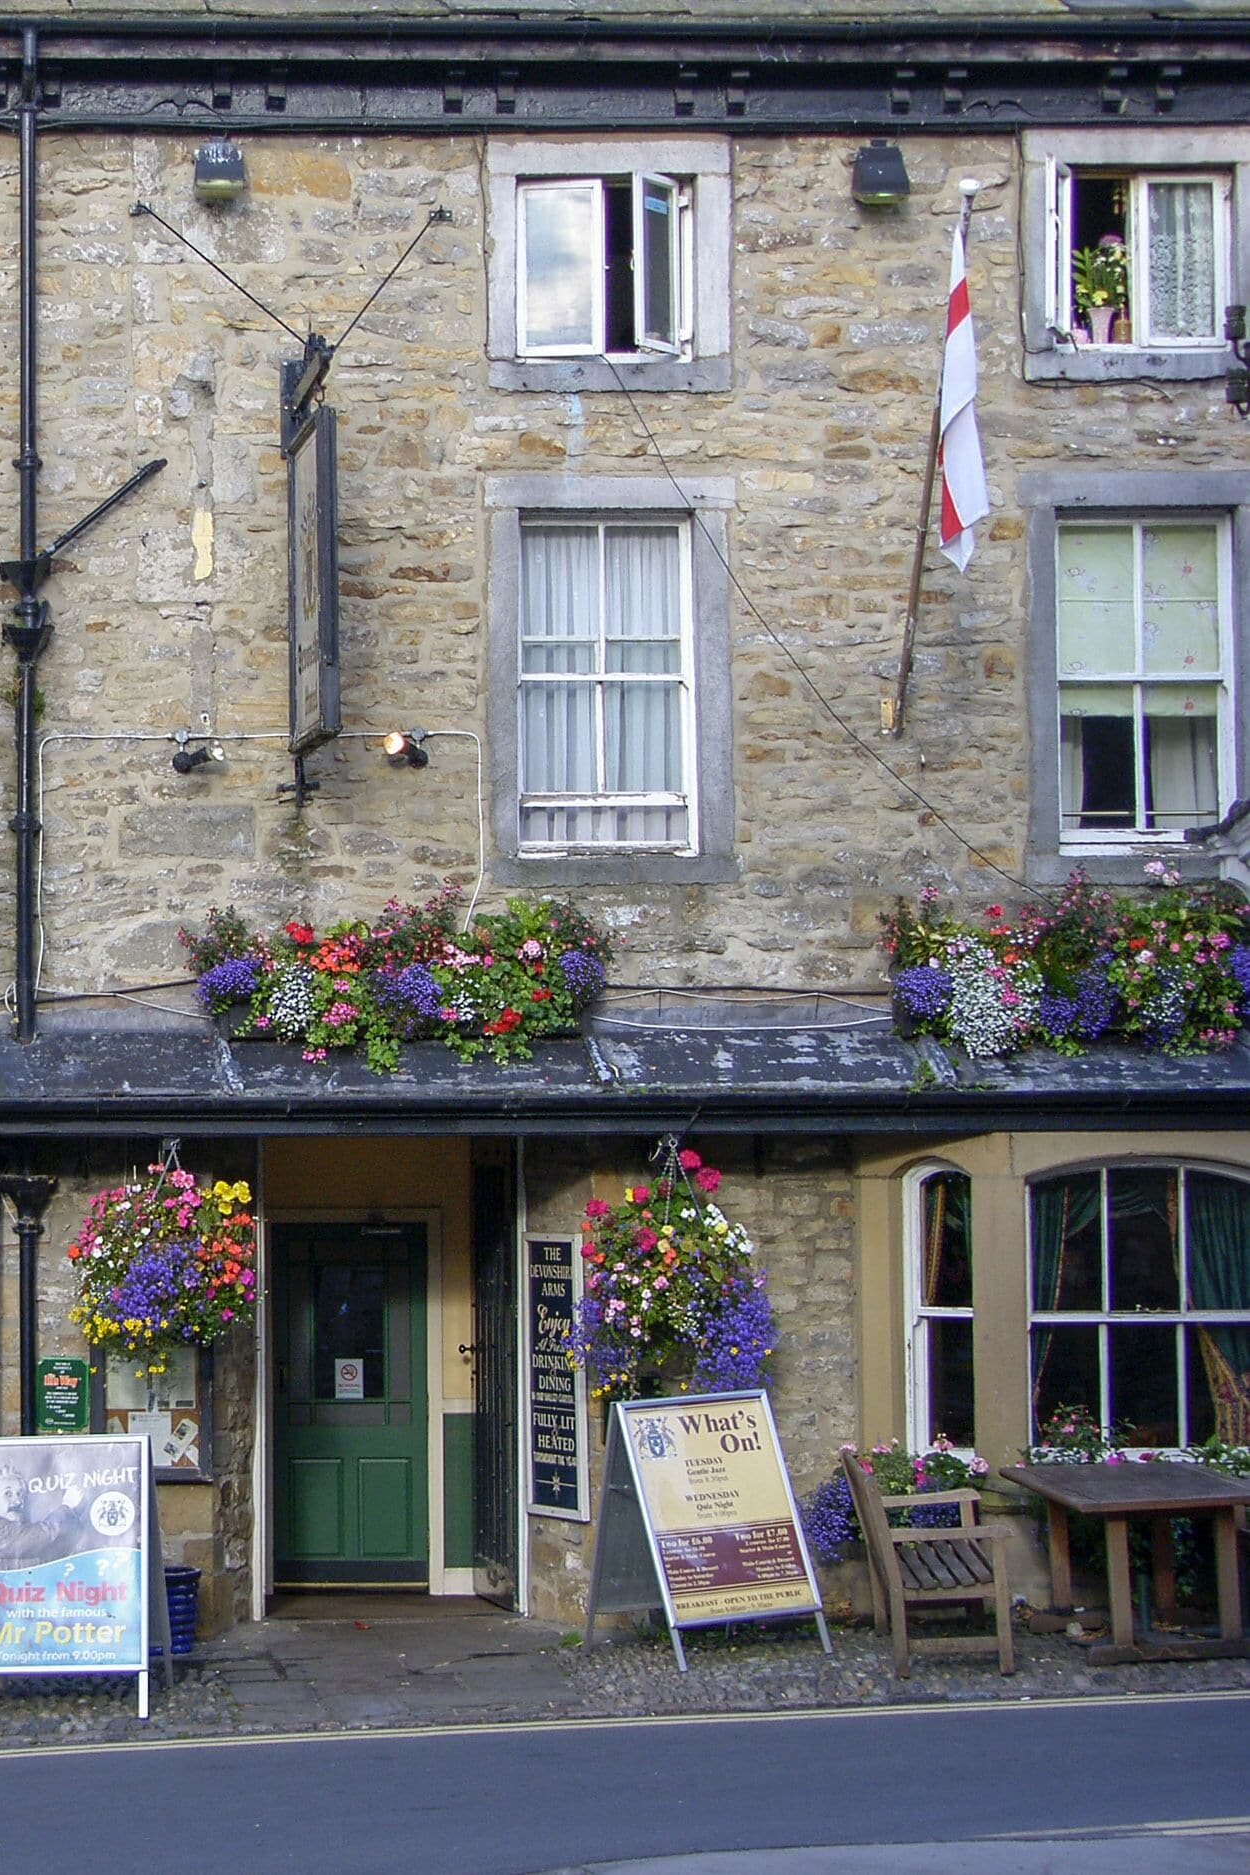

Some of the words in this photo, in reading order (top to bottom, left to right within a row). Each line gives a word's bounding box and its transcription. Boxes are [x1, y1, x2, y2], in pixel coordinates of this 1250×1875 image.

[544, 1247, 562, 1261] THE
[530, 1264, 572, 1279] DEVONSHIR
[542, 1283, 565, 1297] ARMS
[532, 1354, 572, 1372] DRINKIN
[538, 1375, 571, 1392] DINING
[533, 1412, 558, 1428] FULLY
[560, 1415, 575, 1431] LIT
[677, 1410, 757, 1435] What's
[538, 1434, 575, 1452] HEATED
[720, 1431, 762, 1454] On!
[685, 1456, 723, 1467] TUESDAY
[685, 1490, 739, 1502] WEDNESDAY
[714, 1500, 734, 1510] Night
[752, 1530, 764, 1539] for
[55, 1580, 127, 1605] Night
[676, 1599, 719, 1610] BREAKFAST
[724, 1595, 746, 1605] OPEN
[747, 1594, 758, 1602] TO
[758, 1592, 773, 1601] THE
[775, 1589, 801, 1599] PUBLIC
[6, 1607, 35, 1619] with
[38, 1607, 58, 1618] the
[61, 1607, 107, 1618] famous
[34, 1621, 126, 1645] Potter
[41, 1650, 70, 1661] from
[72, 1650, 116, 1663] 9.00pm
